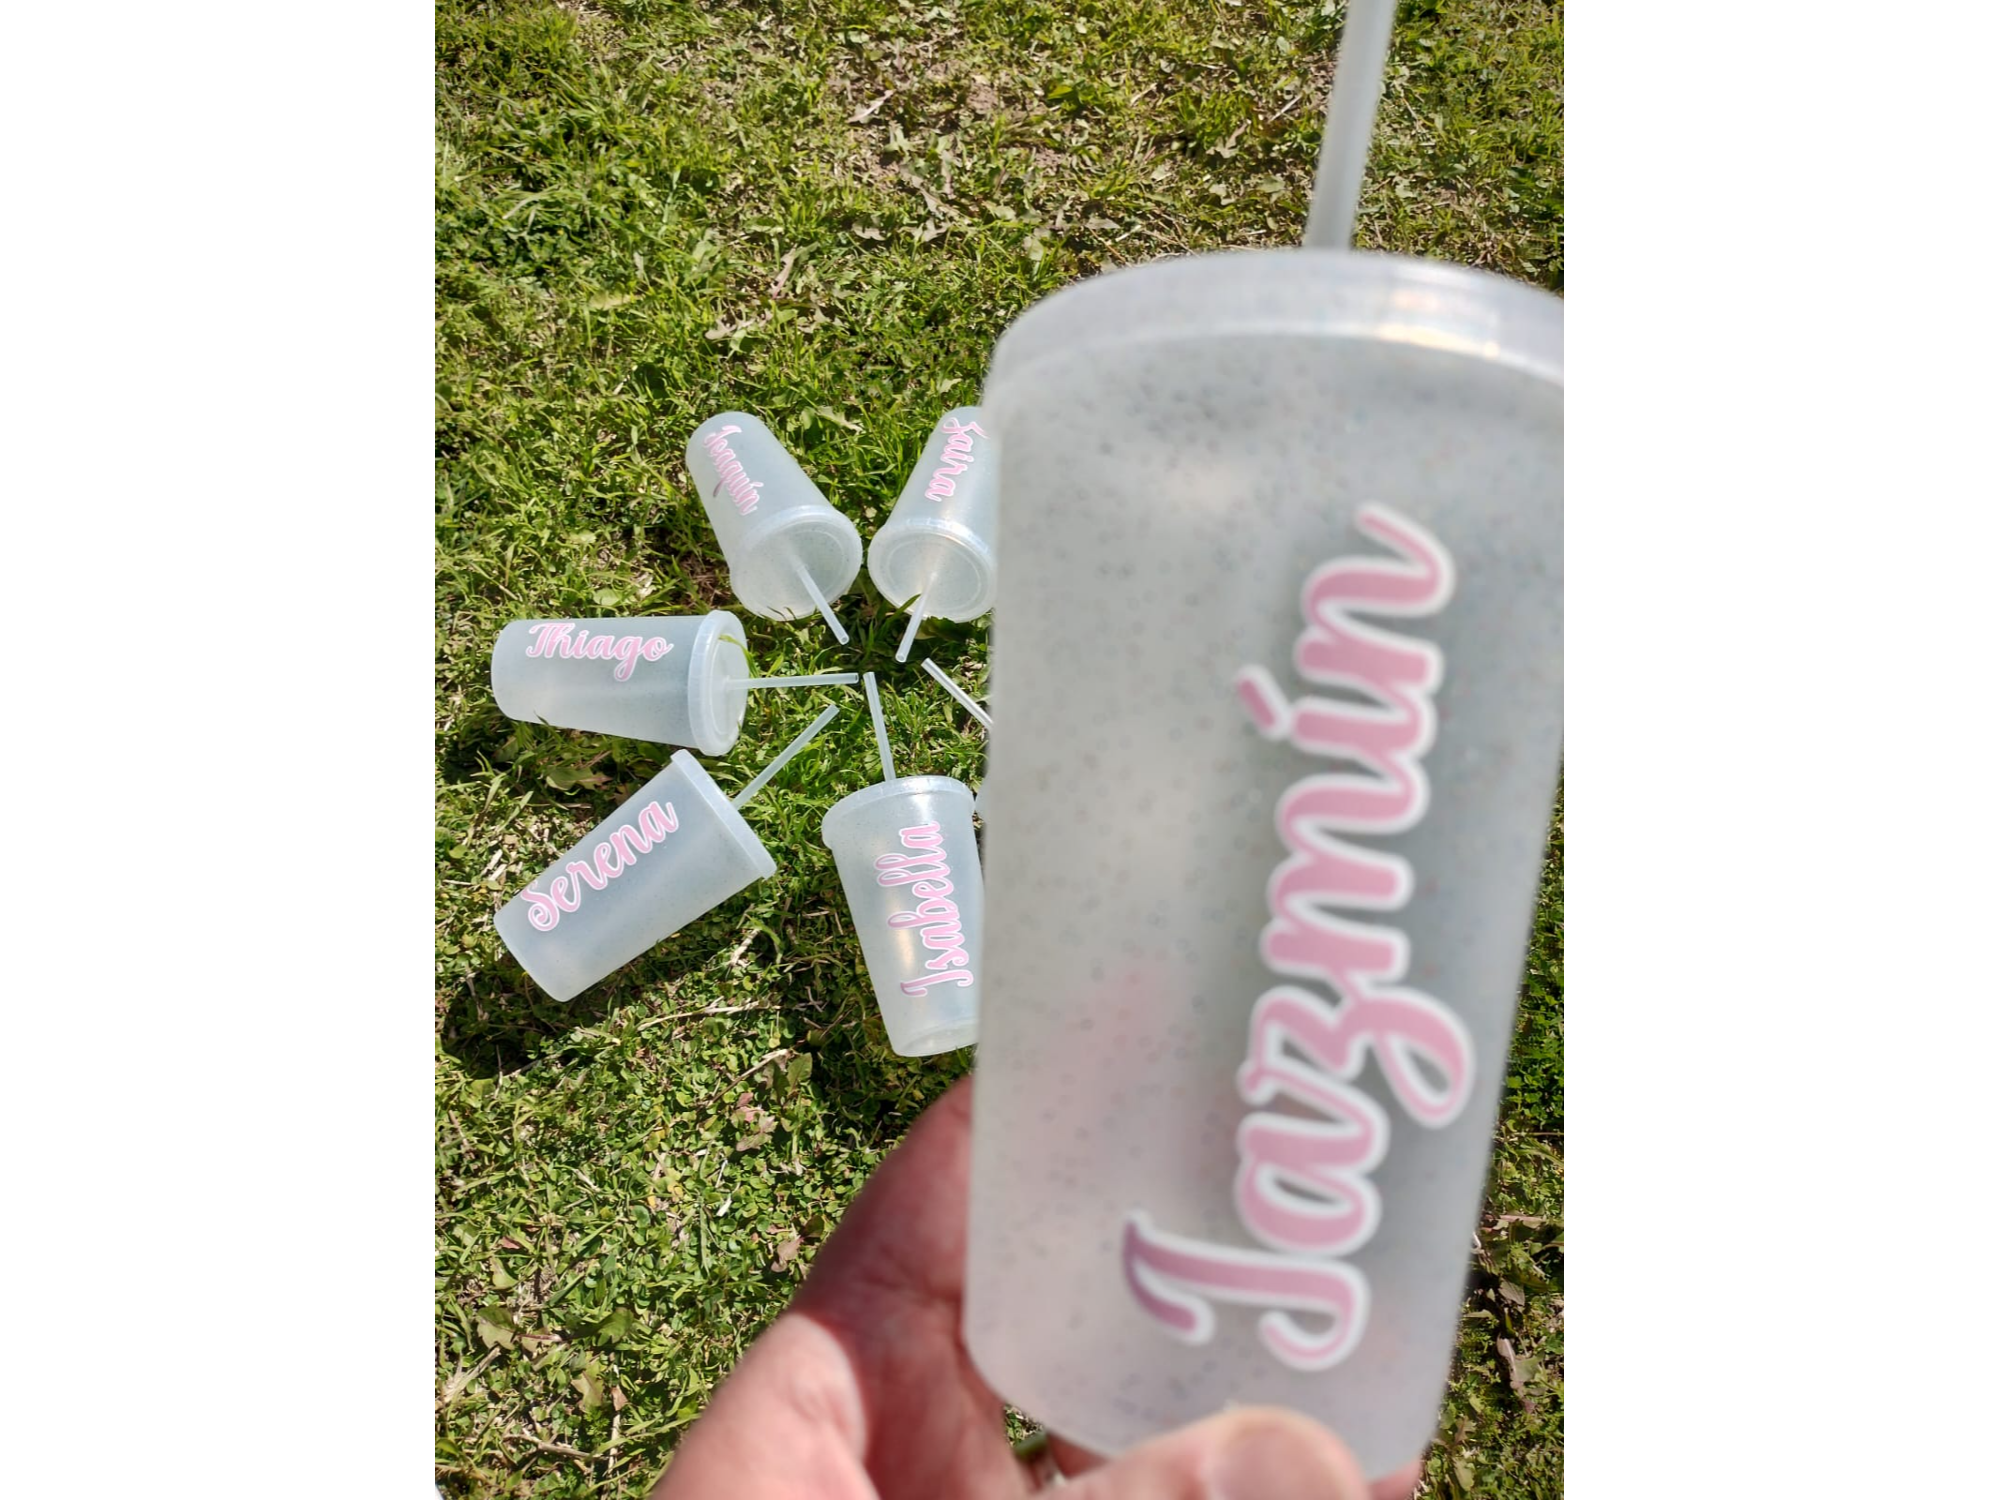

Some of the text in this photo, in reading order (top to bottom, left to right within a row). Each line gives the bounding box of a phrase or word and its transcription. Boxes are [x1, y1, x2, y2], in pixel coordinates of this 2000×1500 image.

[702, 424, 763, 516] Joaquín
[525, 621, 674, 682] Thiago
[521, 800, 680, 932] Serena
[876, 821, 973, 997] Isabella
[1123, 504, 1474, 1371] Jazmín
